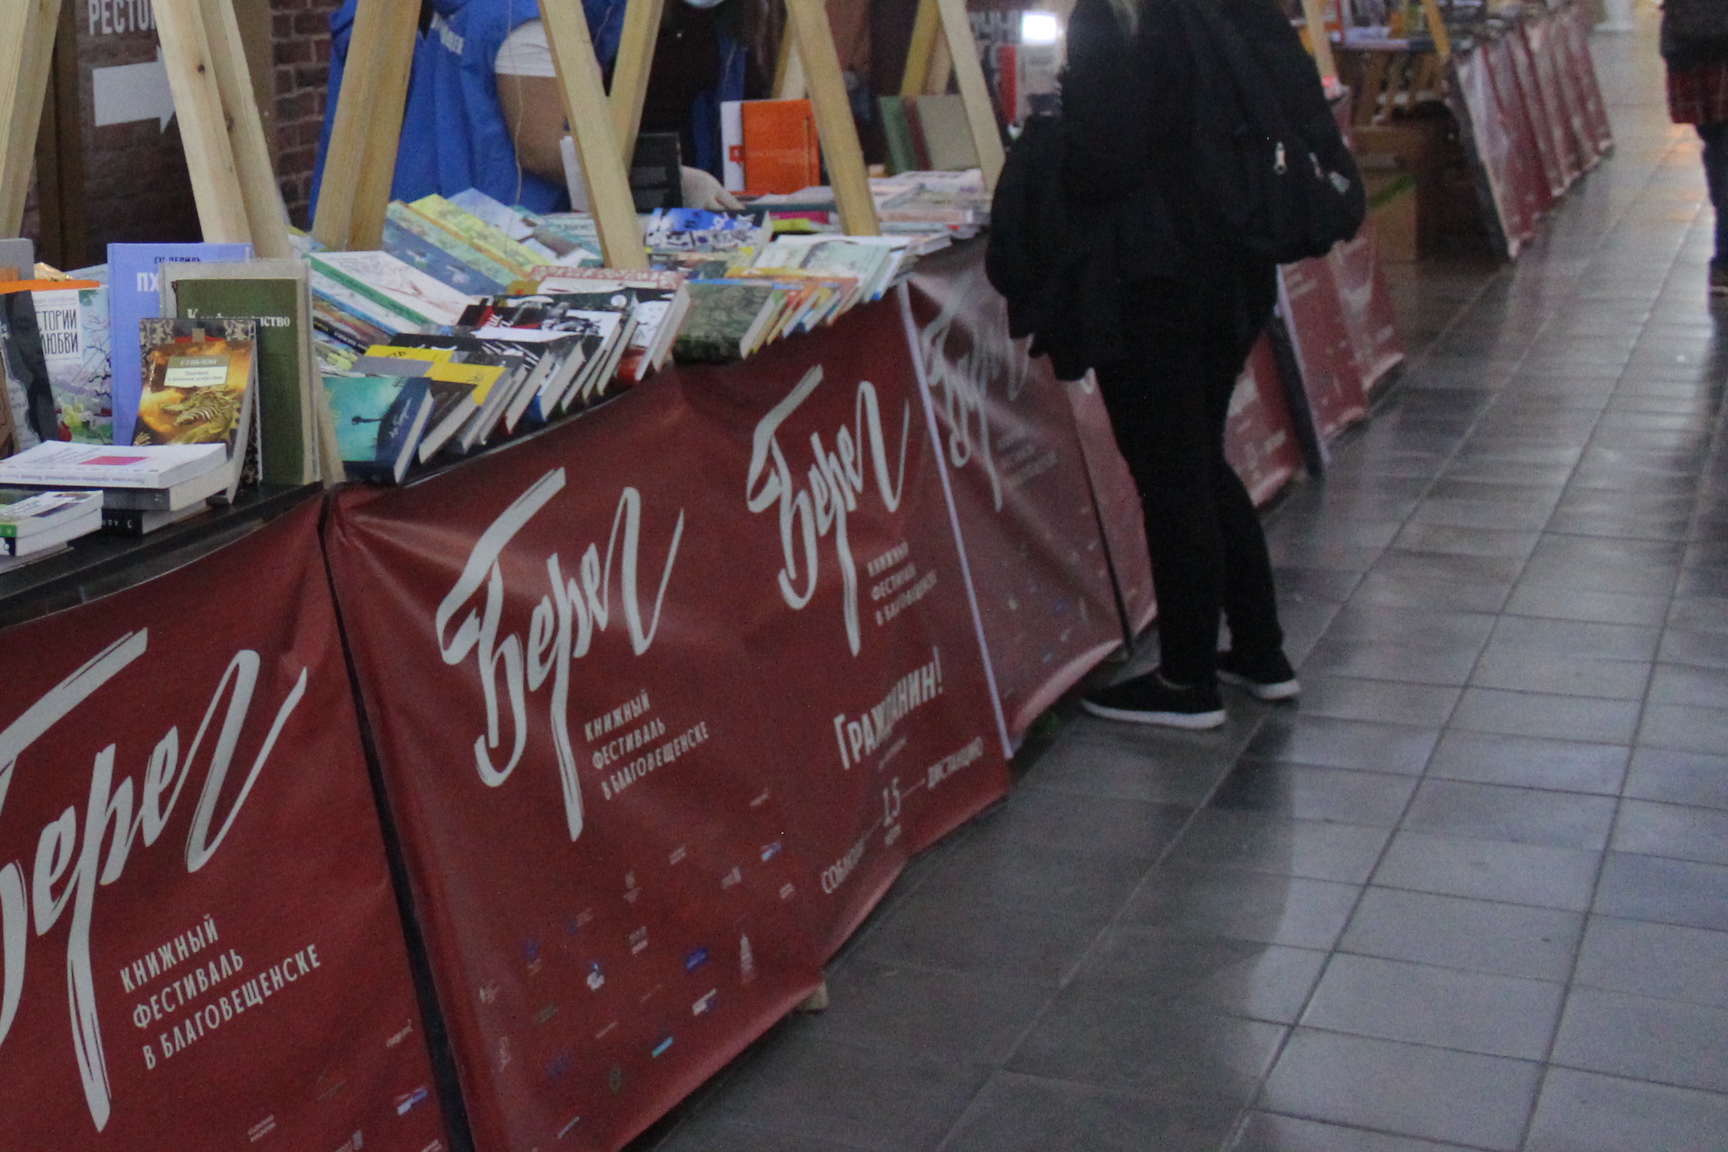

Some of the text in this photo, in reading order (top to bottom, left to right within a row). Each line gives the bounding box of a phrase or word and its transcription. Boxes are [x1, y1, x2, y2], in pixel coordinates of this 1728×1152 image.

[746, 364, 909, 656] Берег
[436, 466, 684, 841] Берег
[592, 717, 666, 769] ФЕСТИВАЛЬ
[119, 915, 219, 993] КНИЖНЫЙ
[133, 949, 245, 1029] ФЕСТИВАЛЬ
[143, 944, 321, 1070] В БЛАГОВЕЩЕНСКЕ
